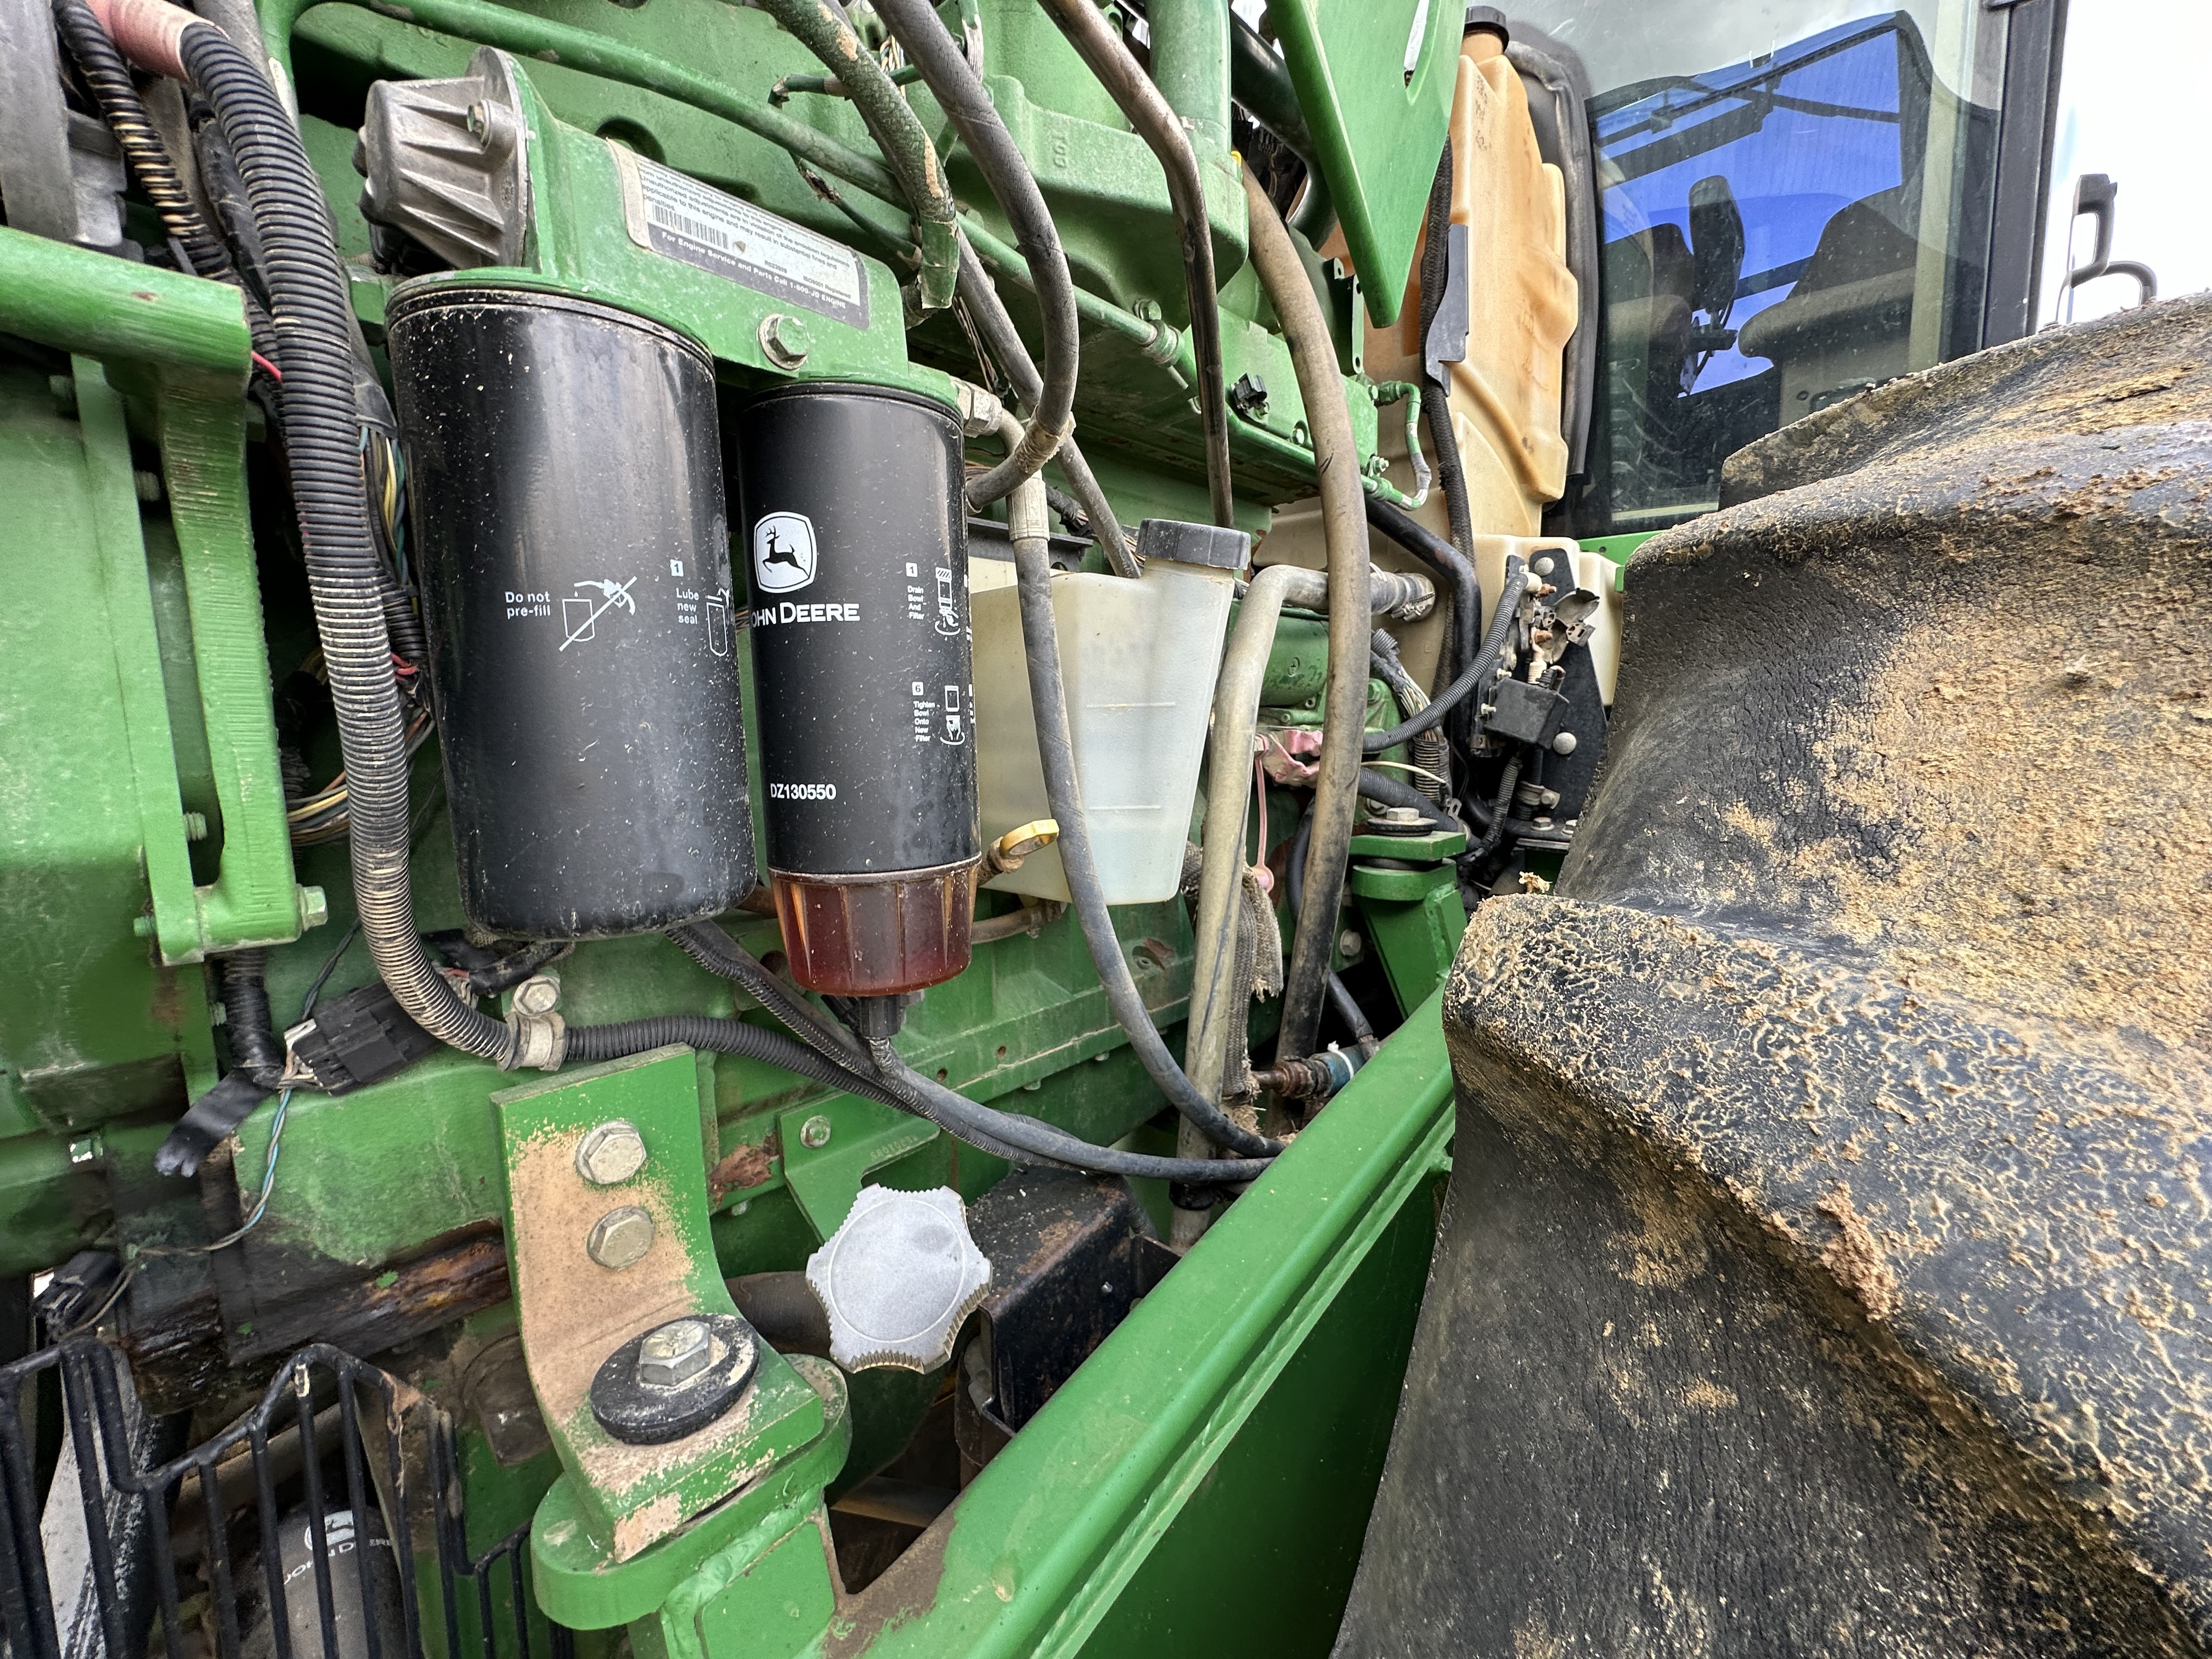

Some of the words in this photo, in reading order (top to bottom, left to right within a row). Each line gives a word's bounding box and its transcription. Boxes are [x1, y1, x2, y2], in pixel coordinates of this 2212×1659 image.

[640, 168, 654, 177] rom
[642, 184, 677, 202] applicable
[688, 203, 700, 212] this
[702, 210, 724, 222] engine
[726, 220, 738, 228] and
[740, 225, 753, 235] may
[689, 196, 728, 216] adjustments
[662, 232, 675, 242] For
[678, 238, 705, 253] Engine
[708, 250, 735, 265] Service
[738, 263, 751, 272] and
[754, 268, 772, 280] Parts
[774, 275, 787, 286] Call
[822, 295, 845, 308] ENGINE
[676, 588, 699, 601] Lube
[907, 585, 924, 594] Drain
[505, 591, 524, 603] Do
[527, 591, 551, 602] not
[507, 606, 551, 619] pre-fill
[677, 603, 697, 612] new
[678, 614, 698, 624] seal
[752, 607, 777, 628] OHN
[780, 602, 860, 624] DEERE
[909, 612, 924, 620] Filter
[913, 701, 935, 709] Tighten
[770, 783, 837, 800] DZ130550
